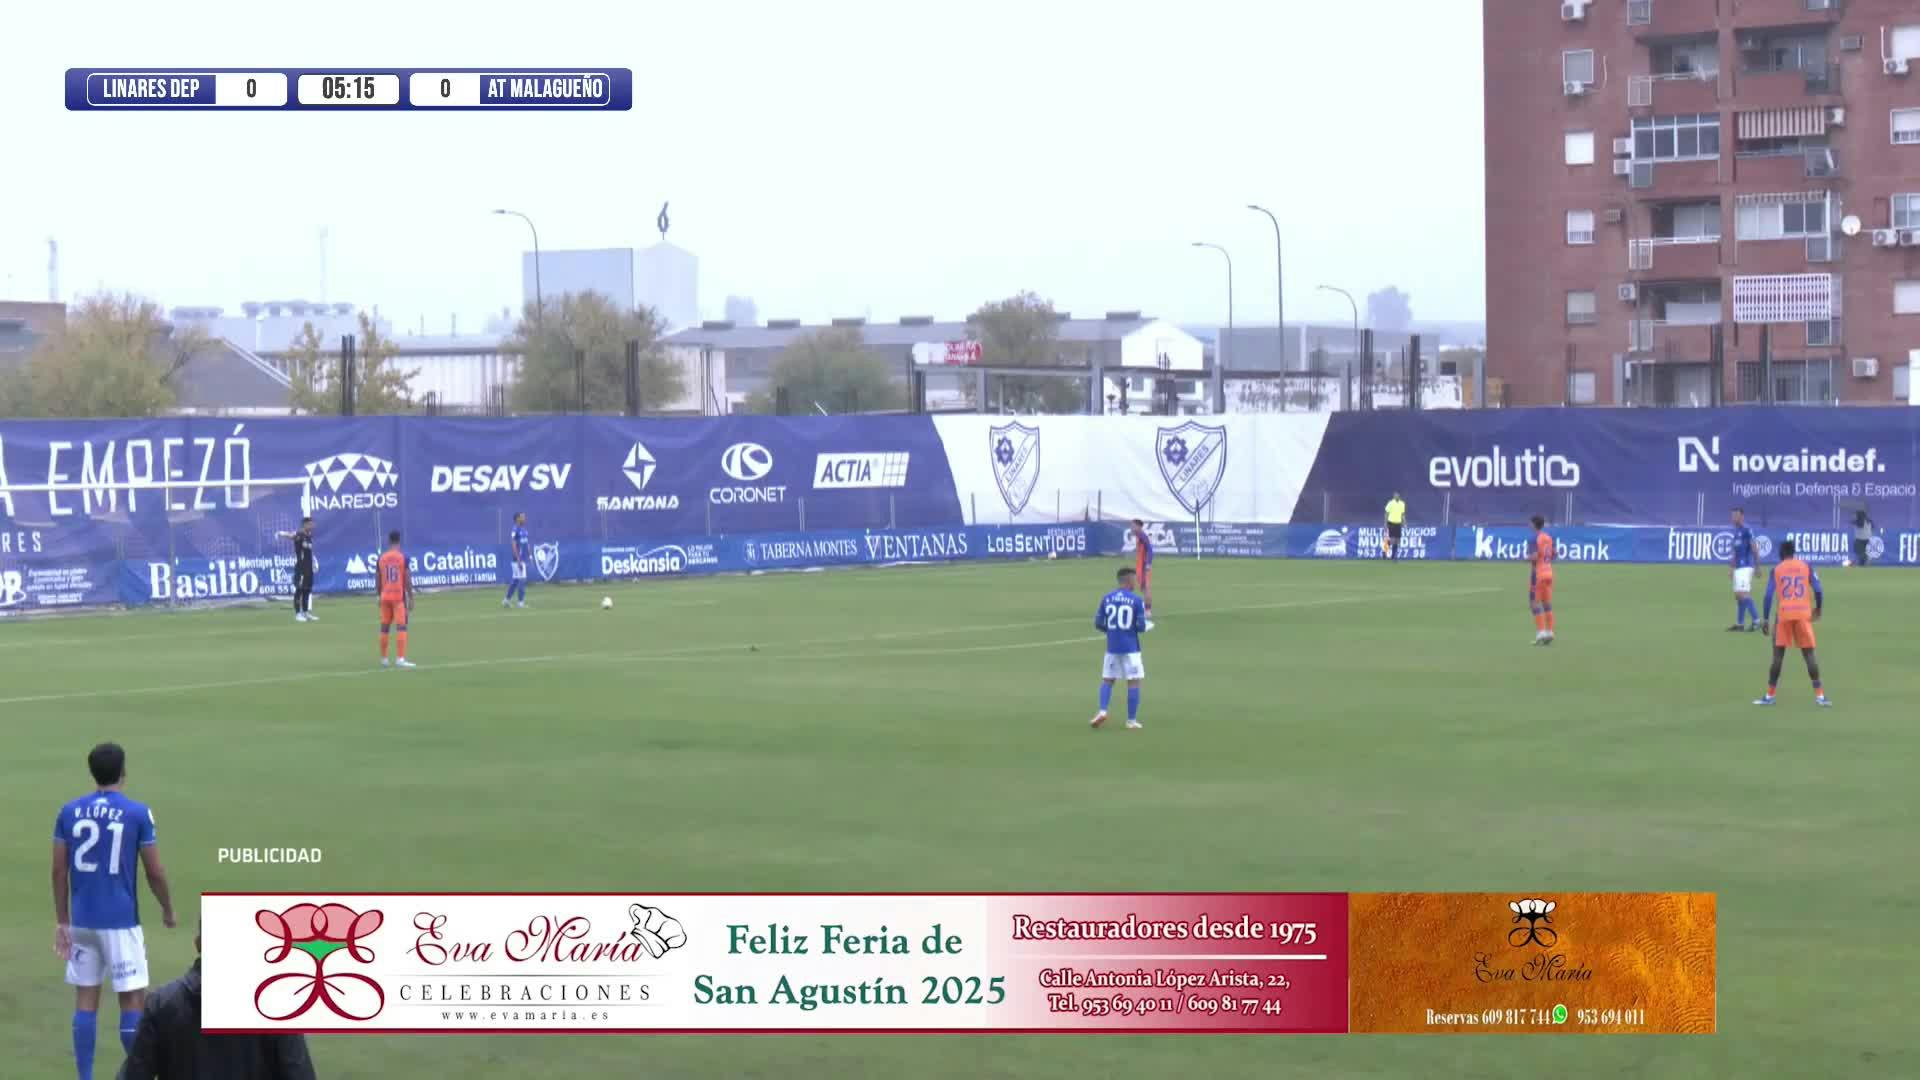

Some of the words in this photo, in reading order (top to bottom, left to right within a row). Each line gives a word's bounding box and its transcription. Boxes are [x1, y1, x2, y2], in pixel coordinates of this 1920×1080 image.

[47, 424, 251, 516] EMPEZÓ
[820, 460, 872, 482] ACTIA
[1732, 448, 1886, 473] novaindef.
[431, 465, 529, 492] DESAY
[529, 463, 572, 490] SV
[709, 486, 787, 504] CORONET
[1795, 483, 1849, 496] Defensa
[1865, 482, 1916, 497] Espacio
[301, 492, 398, 511] INAREJOS
[597, 495, 680, 511] SANTANA
[760, 542, 812, 560] TABERNA
[813, 539, 857, 557] MONTES
[865, 533, 968, 559] VENTANAS
[423, 550, 497, 571] Catalina
[602, 551, 680, 575] Deskansia
[148, 559, 259, 599] Basilio
[1780, 576, 1805, 599] 25
[1105, 604, 1133, 629] 20
[72, 819, 124, 874] 21
